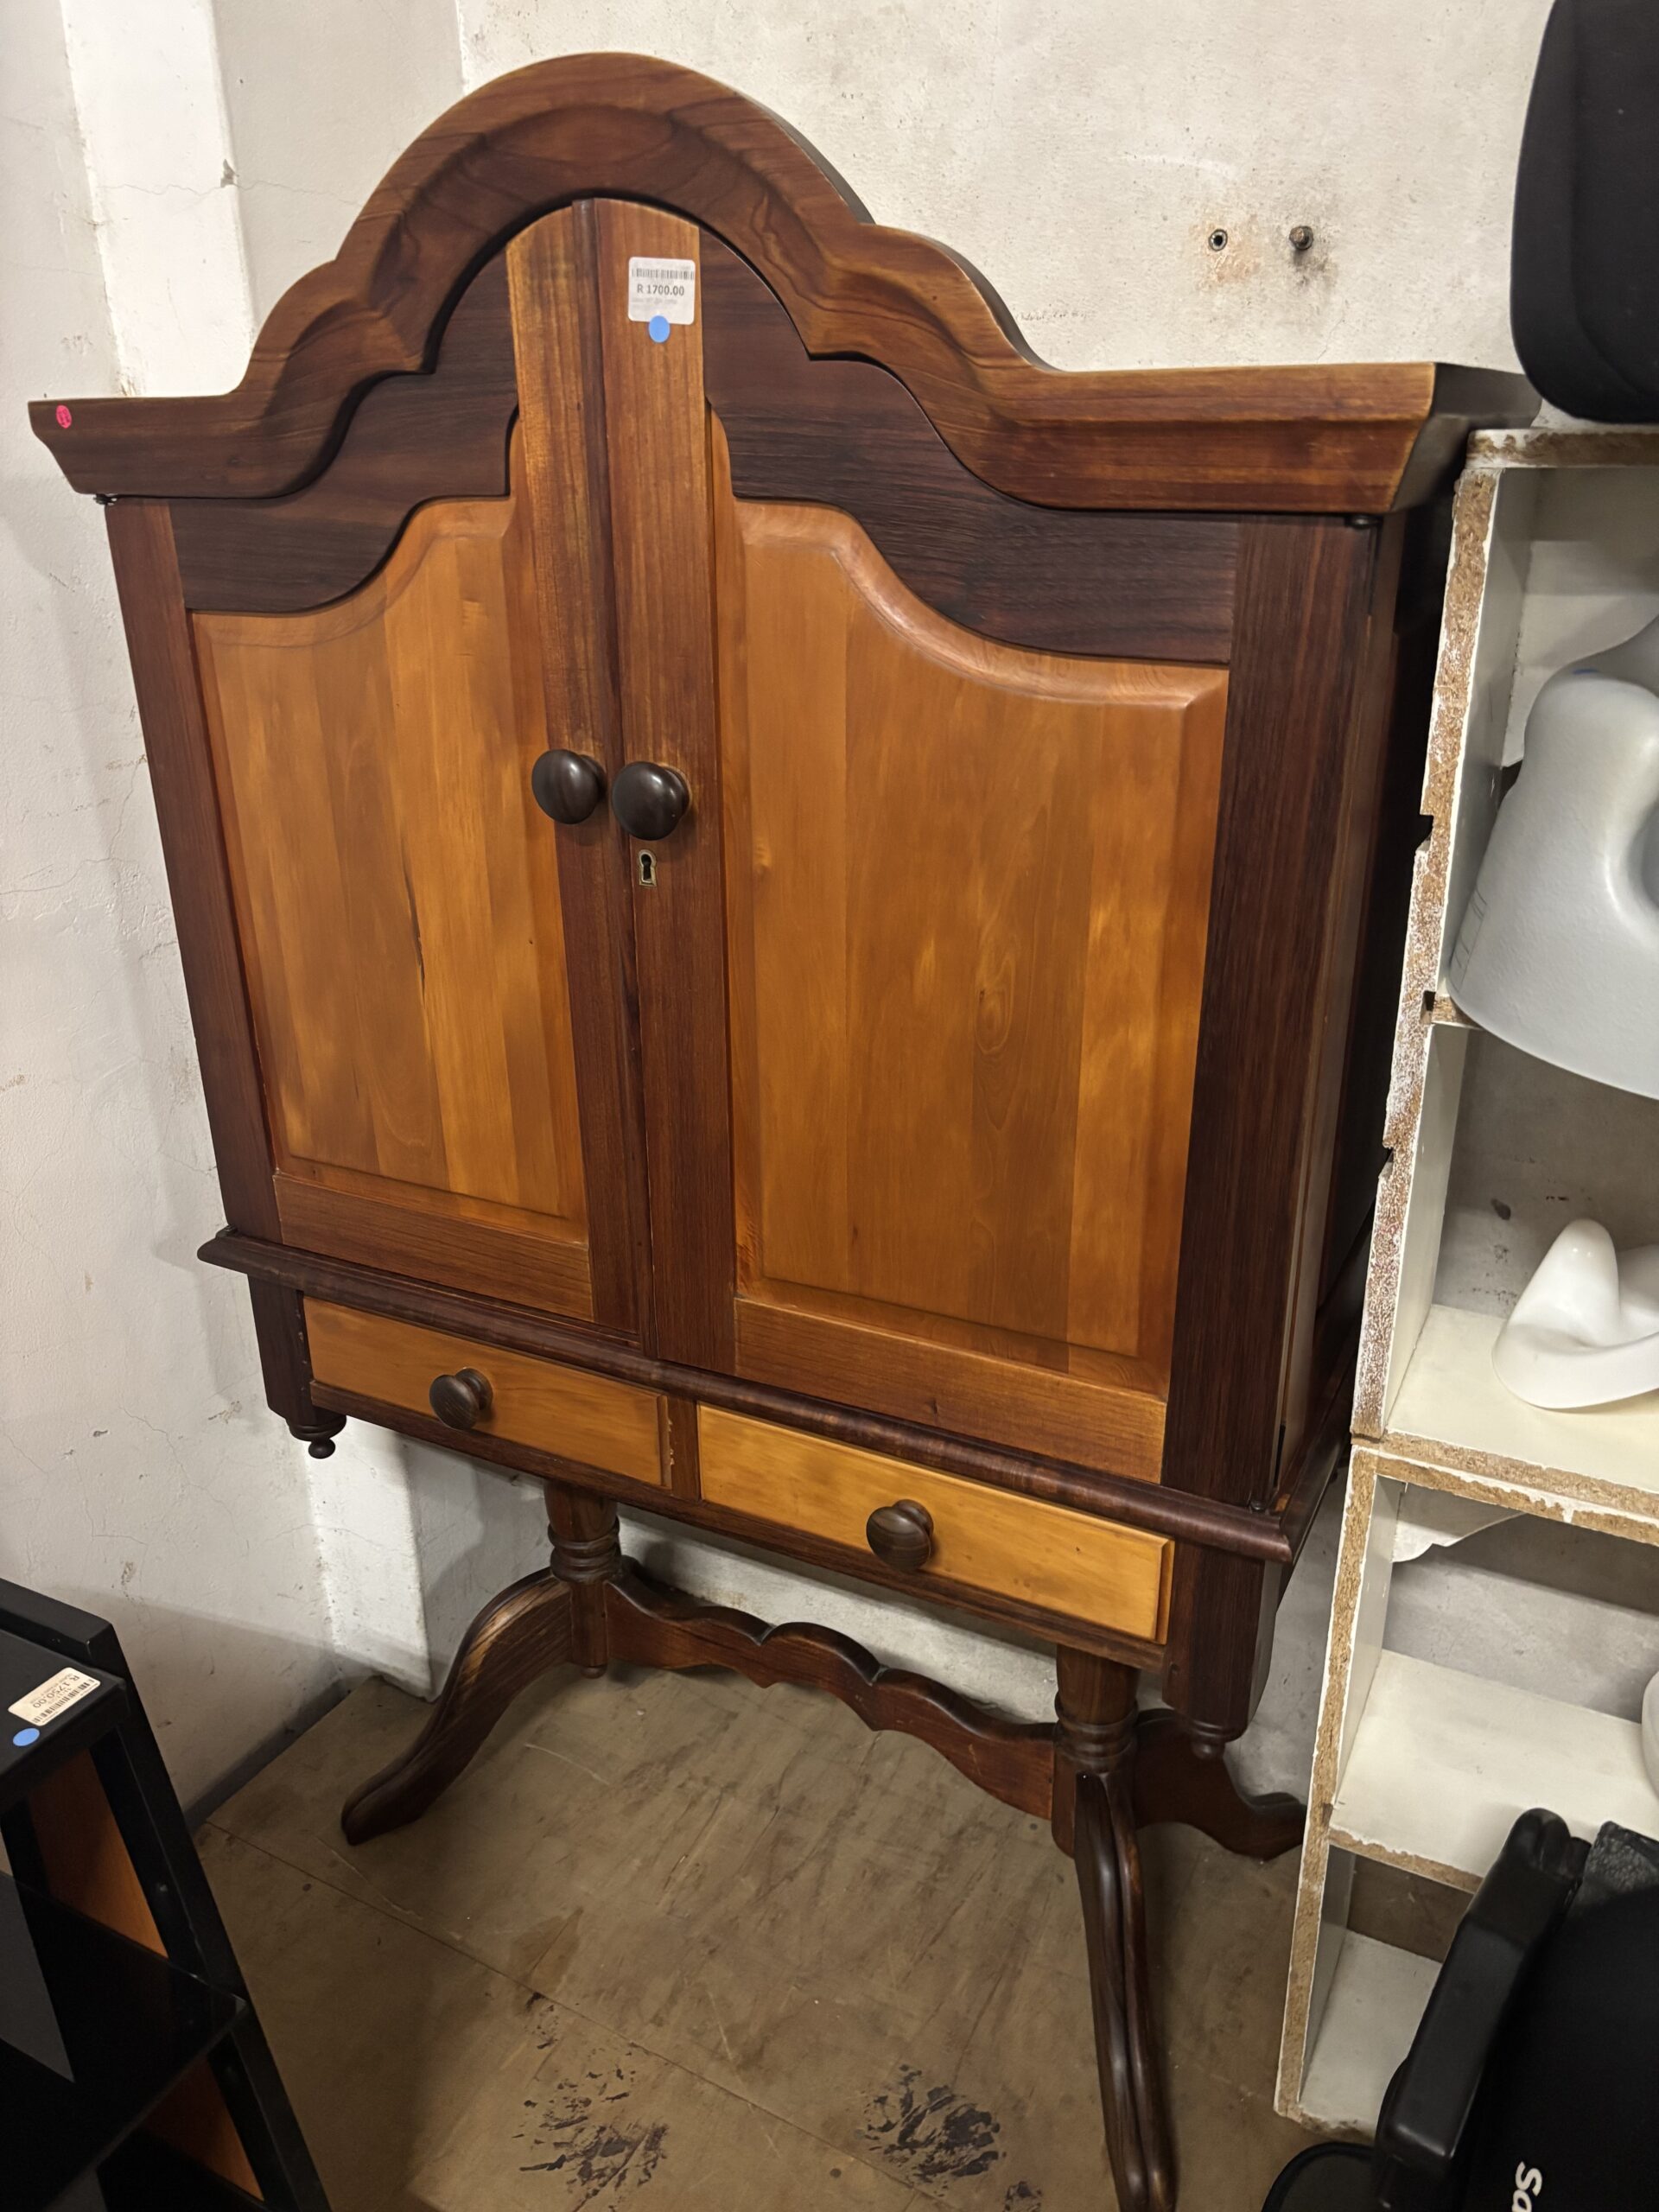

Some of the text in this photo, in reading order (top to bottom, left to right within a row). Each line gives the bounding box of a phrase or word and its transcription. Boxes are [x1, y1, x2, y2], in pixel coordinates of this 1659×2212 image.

[637, 283, 685, 296] R 1700.00
[33, 1681, 71, 1708] 1750.00
